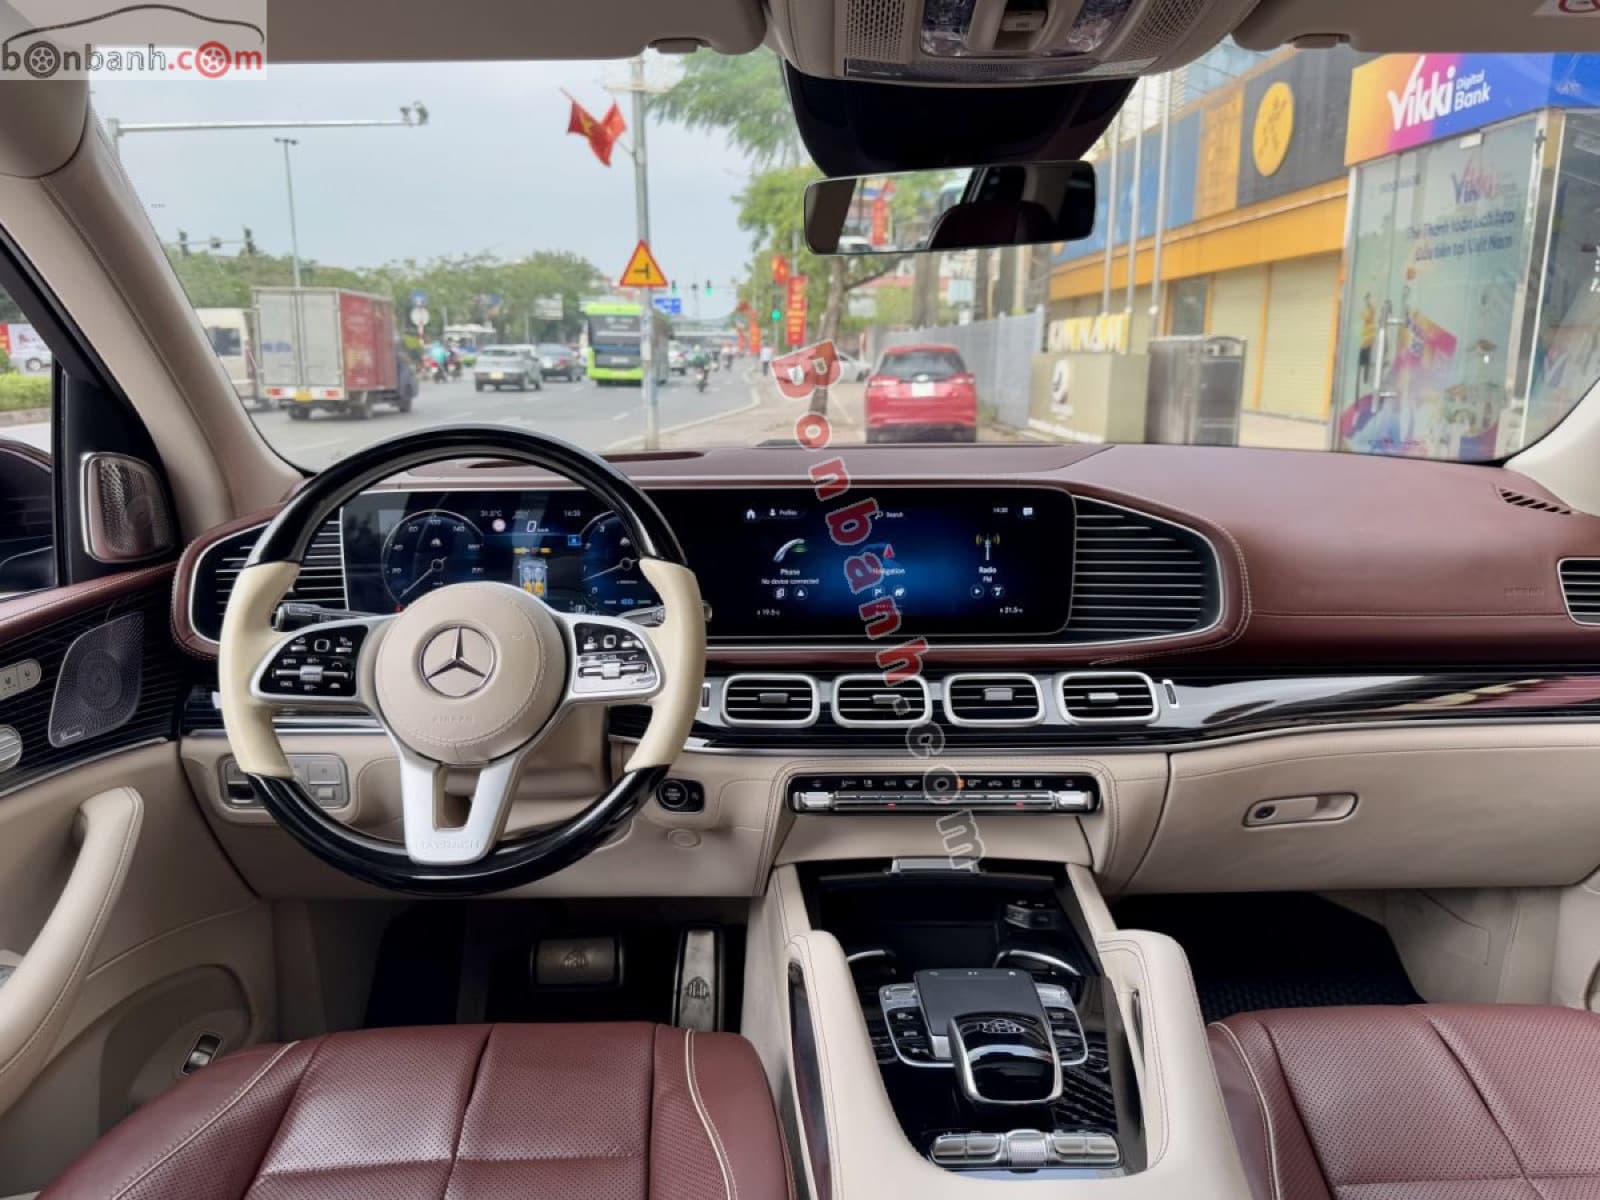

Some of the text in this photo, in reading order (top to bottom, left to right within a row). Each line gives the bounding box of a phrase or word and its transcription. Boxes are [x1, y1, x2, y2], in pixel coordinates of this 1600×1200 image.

[1456, 69, 1485, 89] Digital
[1387, 54, 1456, 131] Vikki
[1455, 82, 1491, 112] Bank
[526, 519, 538, 533] 0
[780, 568, 801, 576] Phone
[872, 567, 906, 577] Navigation
[978, 566, 997, 574] Radio
